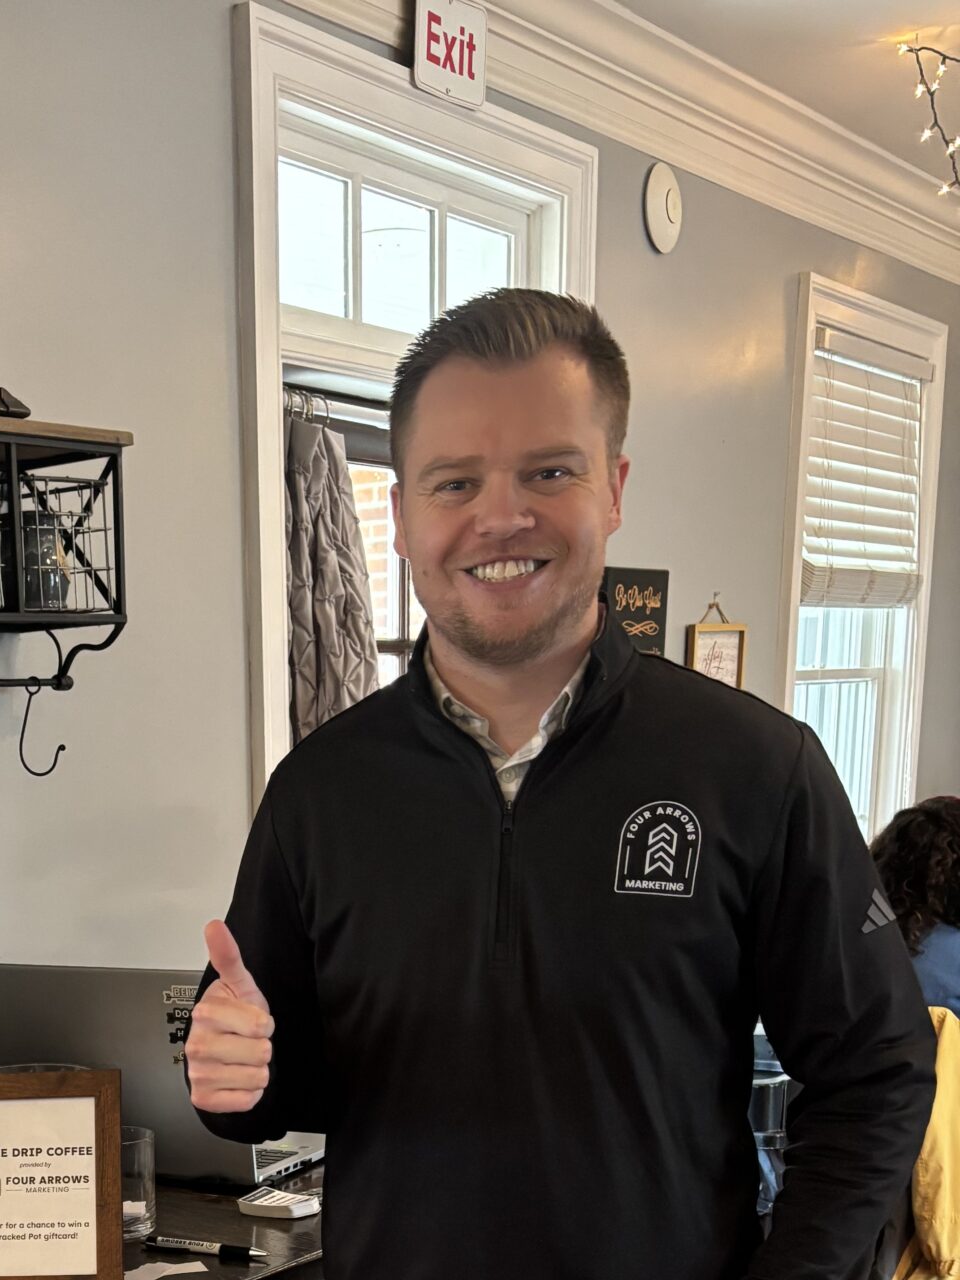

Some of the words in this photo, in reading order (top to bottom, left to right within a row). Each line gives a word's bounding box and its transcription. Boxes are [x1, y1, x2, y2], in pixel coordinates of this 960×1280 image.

[426, 10, 476, 80] Exit
[626, 810, 652, 839] FOUR
[656, 806, 696, 841] ARROWS
[625, 879, 685, 892] MARKETING
[175, 1010, 189, 1018] DO
[12, 1147, 43, 1157] DRIP
[46, 1146, 93, 1157] COFFEE
[5, 1176, 36, 1185] FOUR
[39, 1175, 90, 1185] ARROWS
[26, 1221, 55, 1229] chance
[67, 1220, 82, 1228] win
[28, 1232, 42, 1240] Pot
[43, 1231, 79, 1242] giftcard!
